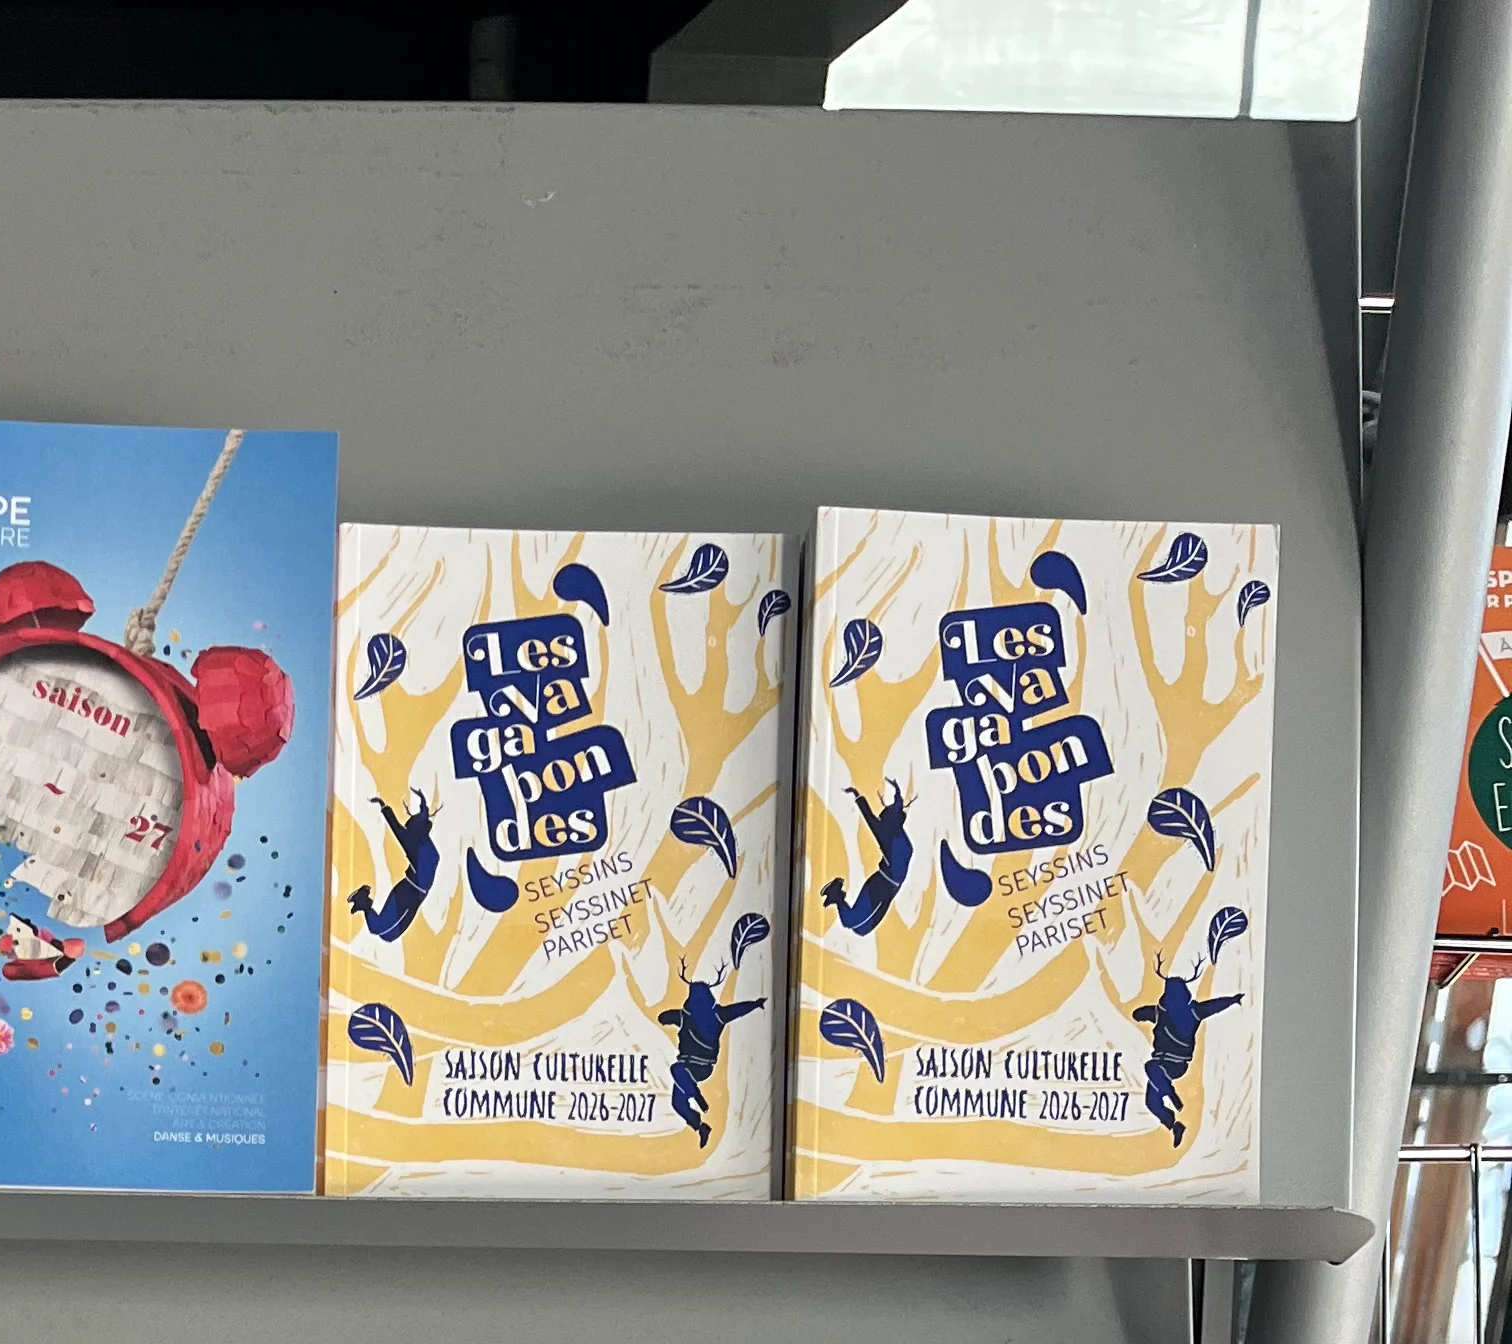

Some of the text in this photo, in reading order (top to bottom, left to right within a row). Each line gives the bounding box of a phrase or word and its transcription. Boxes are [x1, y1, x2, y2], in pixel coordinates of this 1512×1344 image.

[32, 679, 131, 738] saison
[125, 814, 174, 851] 27
[523, 851, 634, 903] SEYSSINS
[997, 844, 1110, 897] SEYSSINS
[533, 879, 655, 934] SEYSSINET
[1006, 871, 1130, 928] SEYSSINET
[542, 913, 634, 962] PARISET
[1015, 909, 1109, 957] PARISET
[444, 1049, 650, 1084] SAISON CULTURELLE
[443, 1087, 657, 1123] COMMUNE 2026-2027
[153, 1131, 266, 1145] DANSE MUSIQUES
